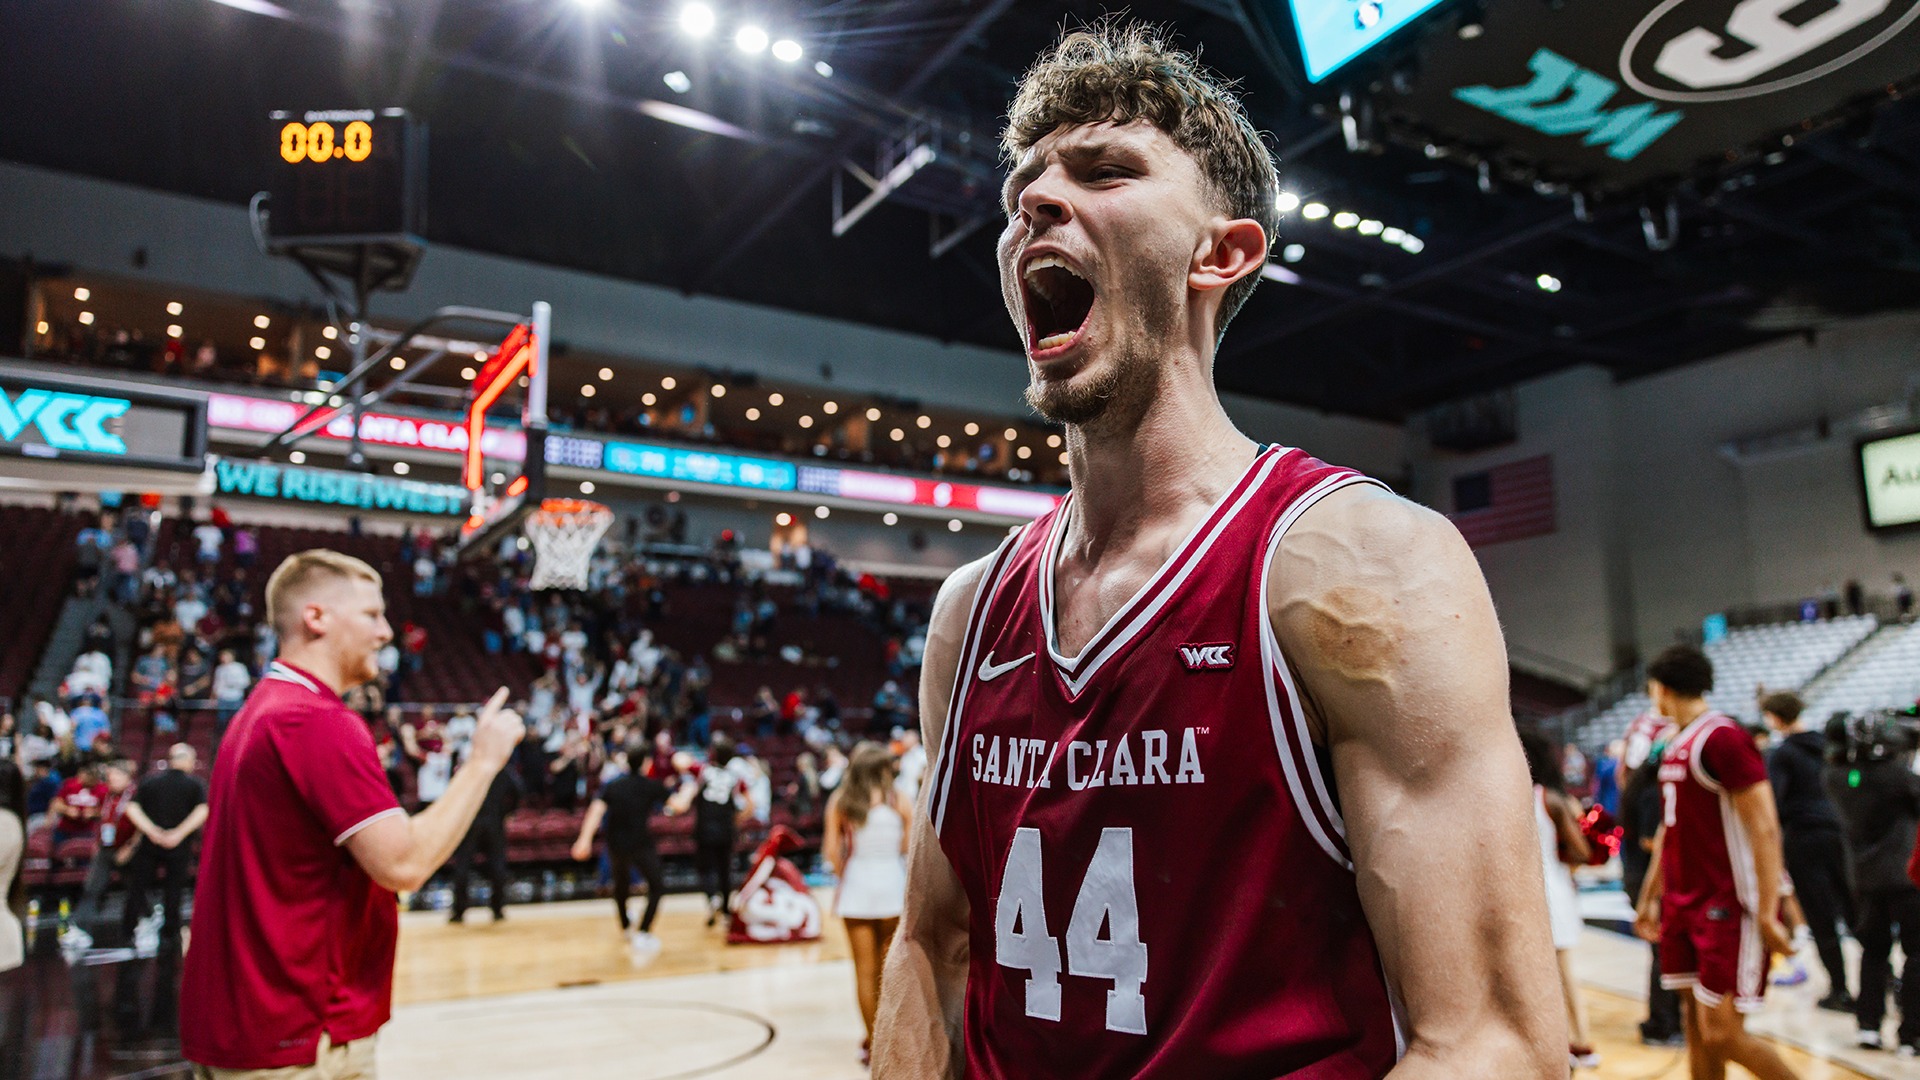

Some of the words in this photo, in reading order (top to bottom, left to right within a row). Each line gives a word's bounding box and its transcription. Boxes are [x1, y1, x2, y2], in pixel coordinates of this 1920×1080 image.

[280, 121, 373, 164] 00.0
[217, 458, 279, 498] WE
[1181, 645, 1231, 666] WCC
[972, 733, 1051, 789] SANTA
[995, 826, 1148, 1036] 44
